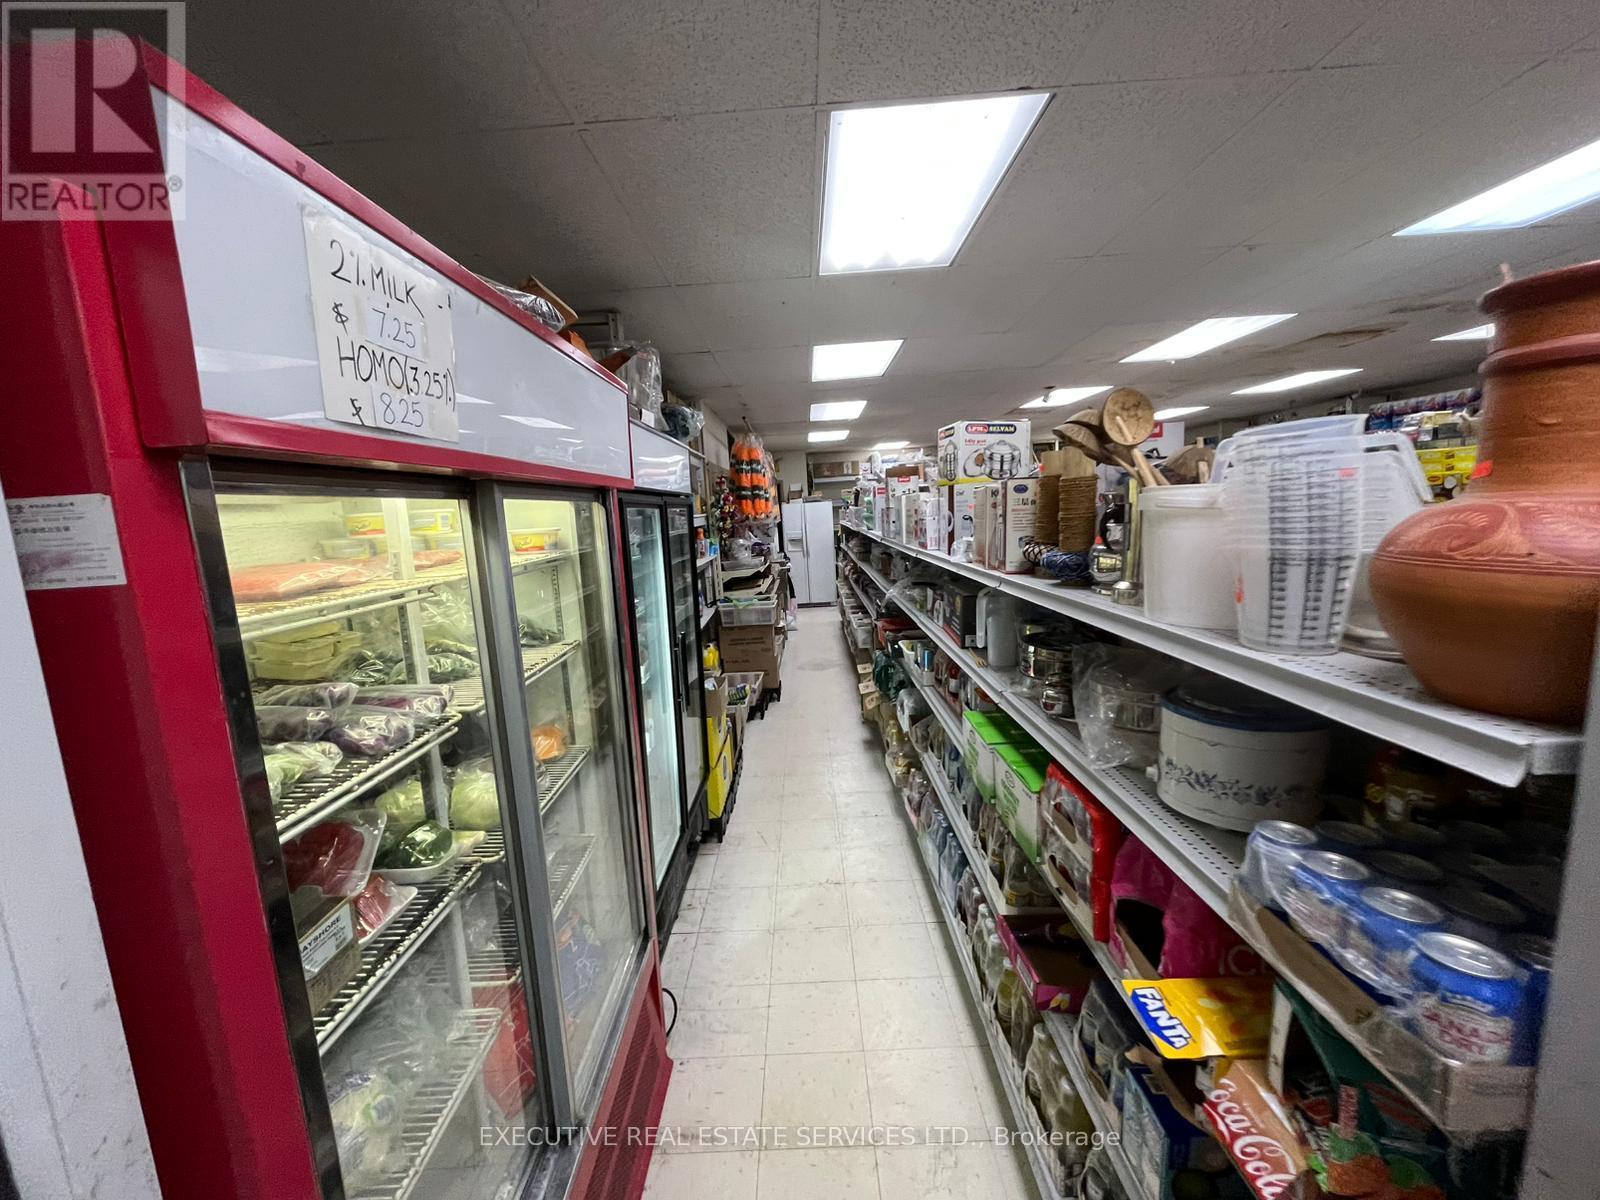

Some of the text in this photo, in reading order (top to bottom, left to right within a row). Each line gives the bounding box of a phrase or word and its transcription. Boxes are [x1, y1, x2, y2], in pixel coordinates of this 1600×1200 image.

[371, 266, 424, 318] MILK
[332, 302, 417, 349] $ 7.25
[350, 392, 424, 428] $ 8.25
[302, 914, 342, 953] AYSHORE
[1133, 987, 1192, 1049] FANTA
